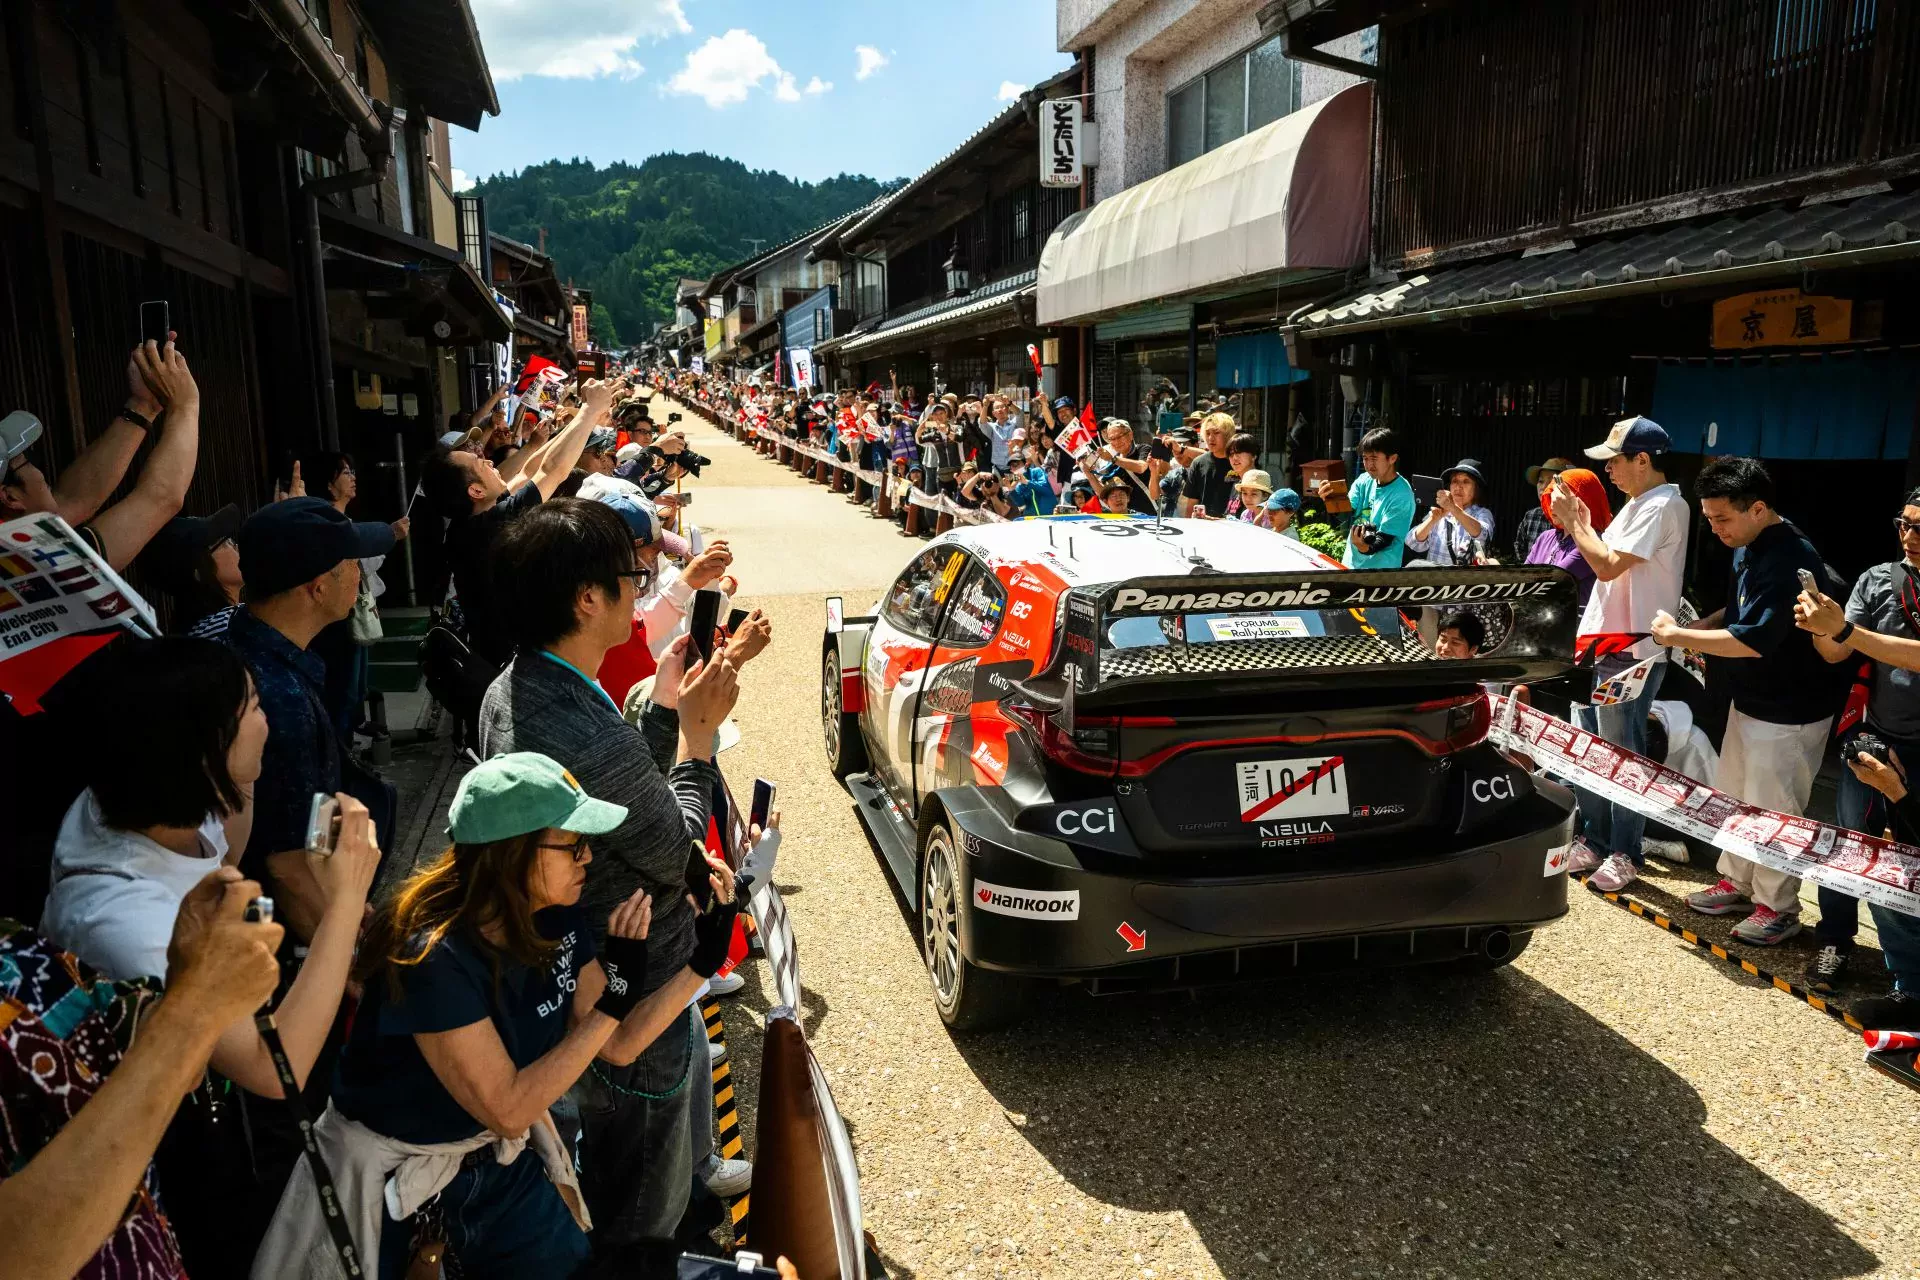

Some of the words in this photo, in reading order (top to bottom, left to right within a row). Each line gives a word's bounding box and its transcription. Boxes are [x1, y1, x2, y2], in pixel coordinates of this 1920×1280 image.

[1088, 522, 1184, 537] 99
[1111, 582, 1331, 612] Panasonic
[1343, 581, 1557, 602] AUTOMOTIVE
[0, 606, 57, 635] Welcome
[55, 603, 69, 615] to
[1162, 614, 1185, 641] Stilo
[1234, 619, 1280, 629] FORUM8
[3, 630, 32, 650] Ena
[30, 620, 59, 638] City
[1067, 631, 1095, 657] DENSO
[1230, 629, 1292, 639] RallyJapan
[1243, 768, 1259, 802] 三河
[1472, 774, 1515, 803] CCi
[1055, 807, 1116, 835] CCi
[1372, 804, 1405, 816] YARIS
